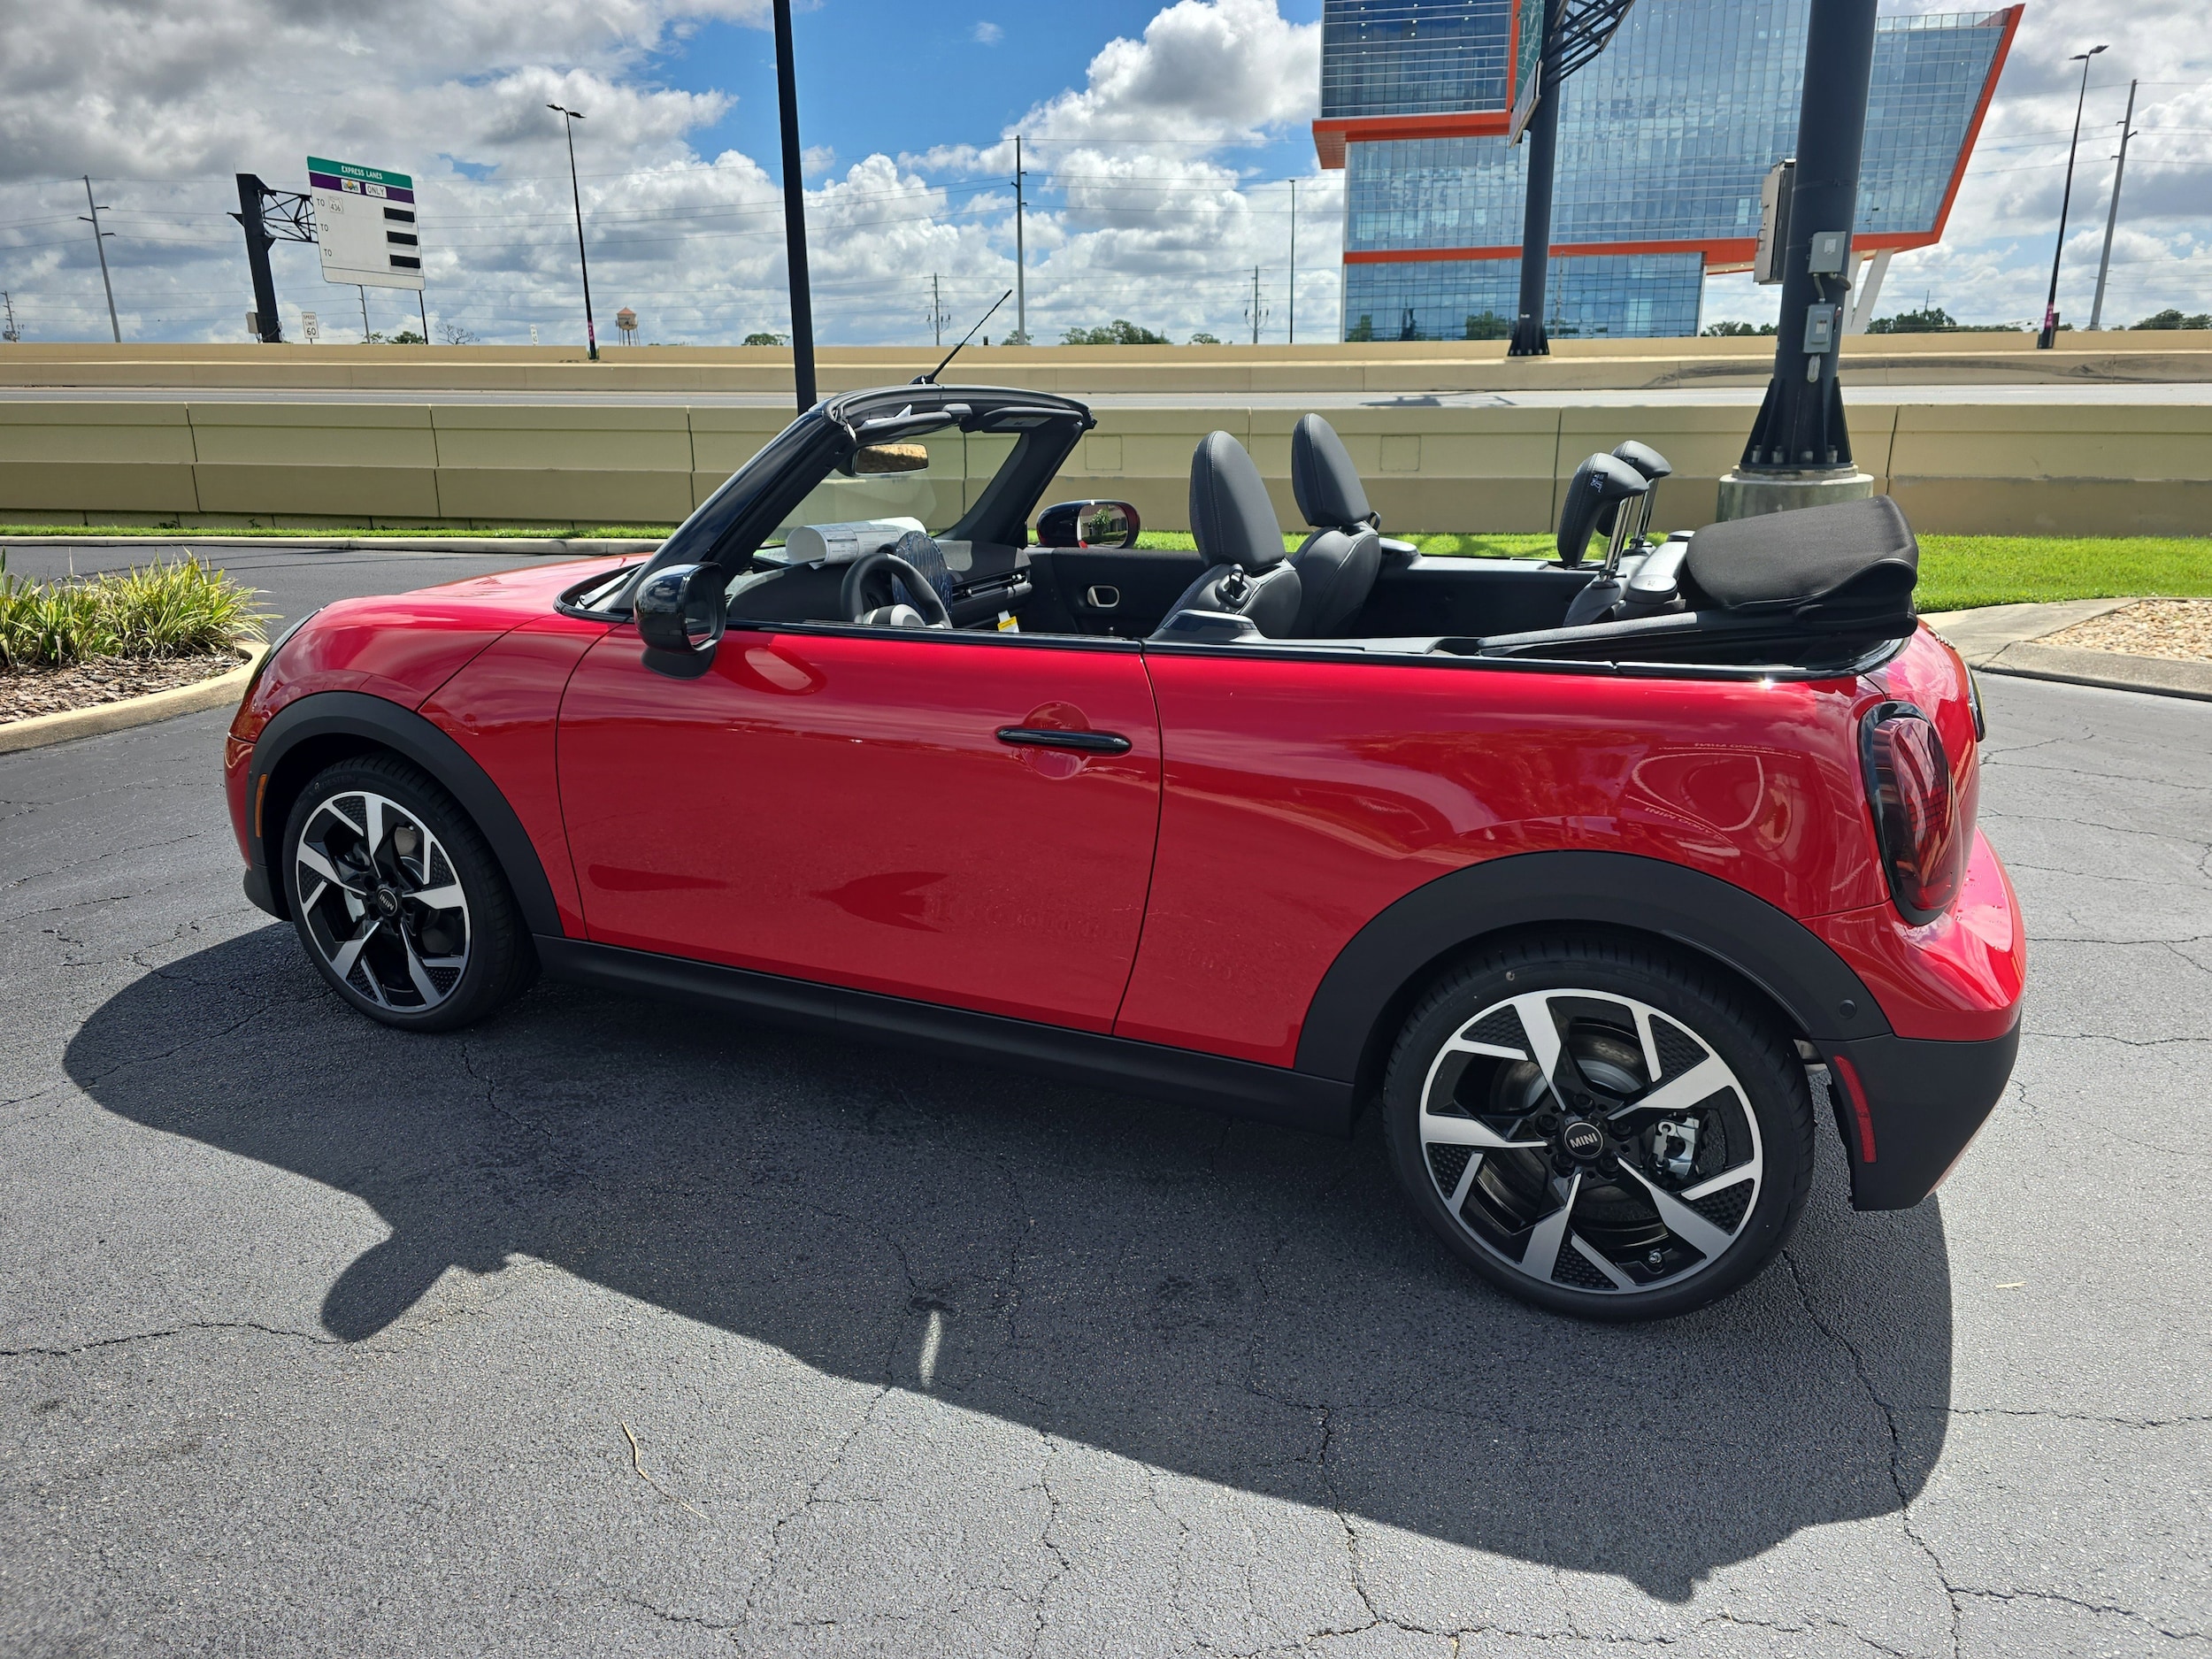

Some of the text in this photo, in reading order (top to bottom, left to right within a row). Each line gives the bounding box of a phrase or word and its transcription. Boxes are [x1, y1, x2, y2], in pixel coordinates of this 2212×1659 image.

[341, 165, 383, 180] EXPRESS LANES
[366, 184, 385, 196] ONLY
[317, 197, 342, 212] TO 436
[320, 223, 329, 232] TO
[324, 249, 333, 257] TO
[306, 326, 317, 336] 60
[378, 894, 396, 911] MINI
[1569, 1132, 1598, 1148] MINI
